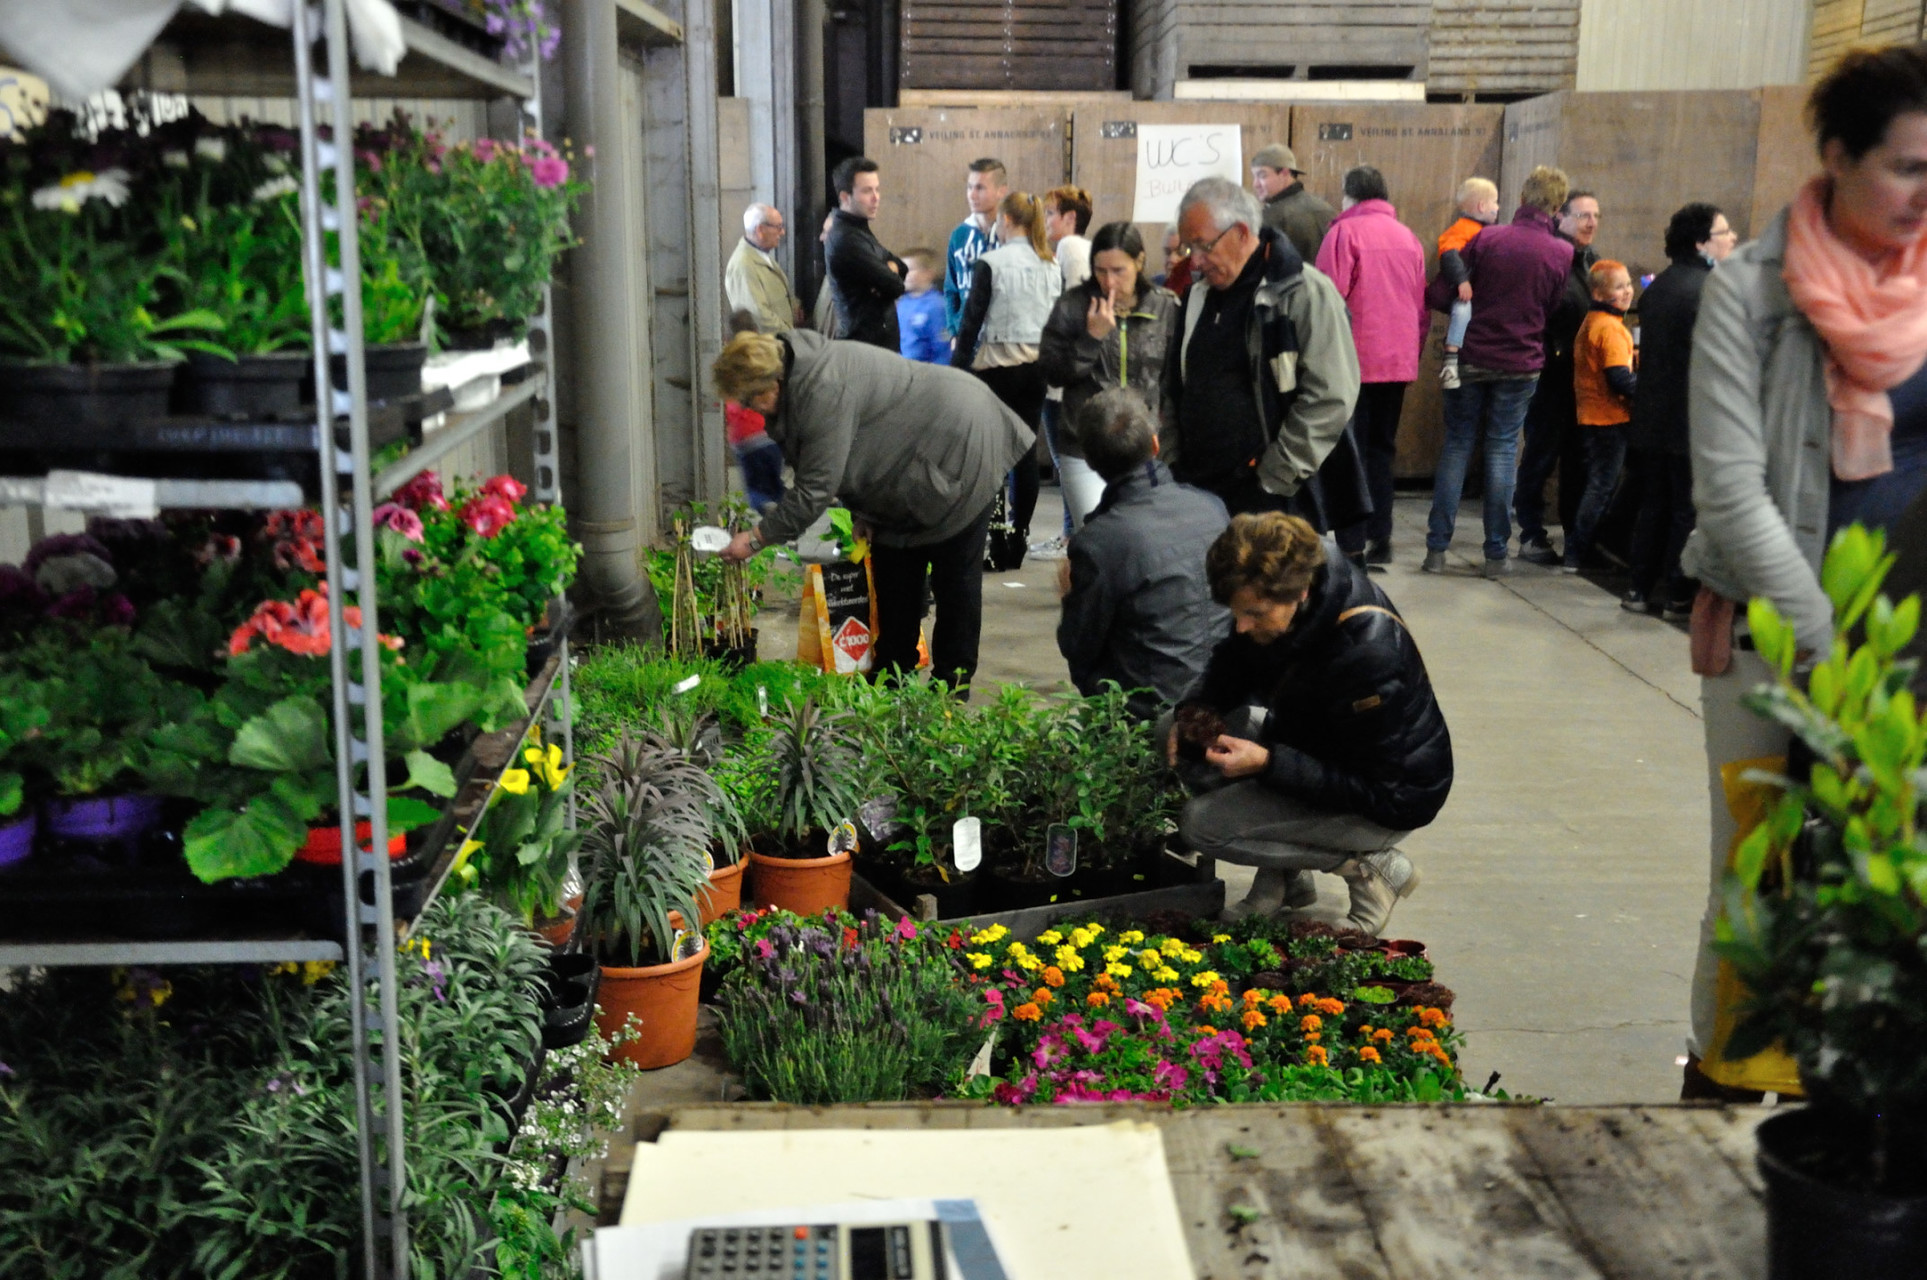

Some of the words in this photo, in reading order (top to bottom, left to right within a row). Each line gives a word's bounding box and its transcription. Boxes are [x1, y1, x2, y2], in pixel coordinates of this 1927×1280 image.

[929, 130, 965, 140] VEILING
[1360, 126, 1398, 137] VEILING
[839, 633, 870, 648] C1000
